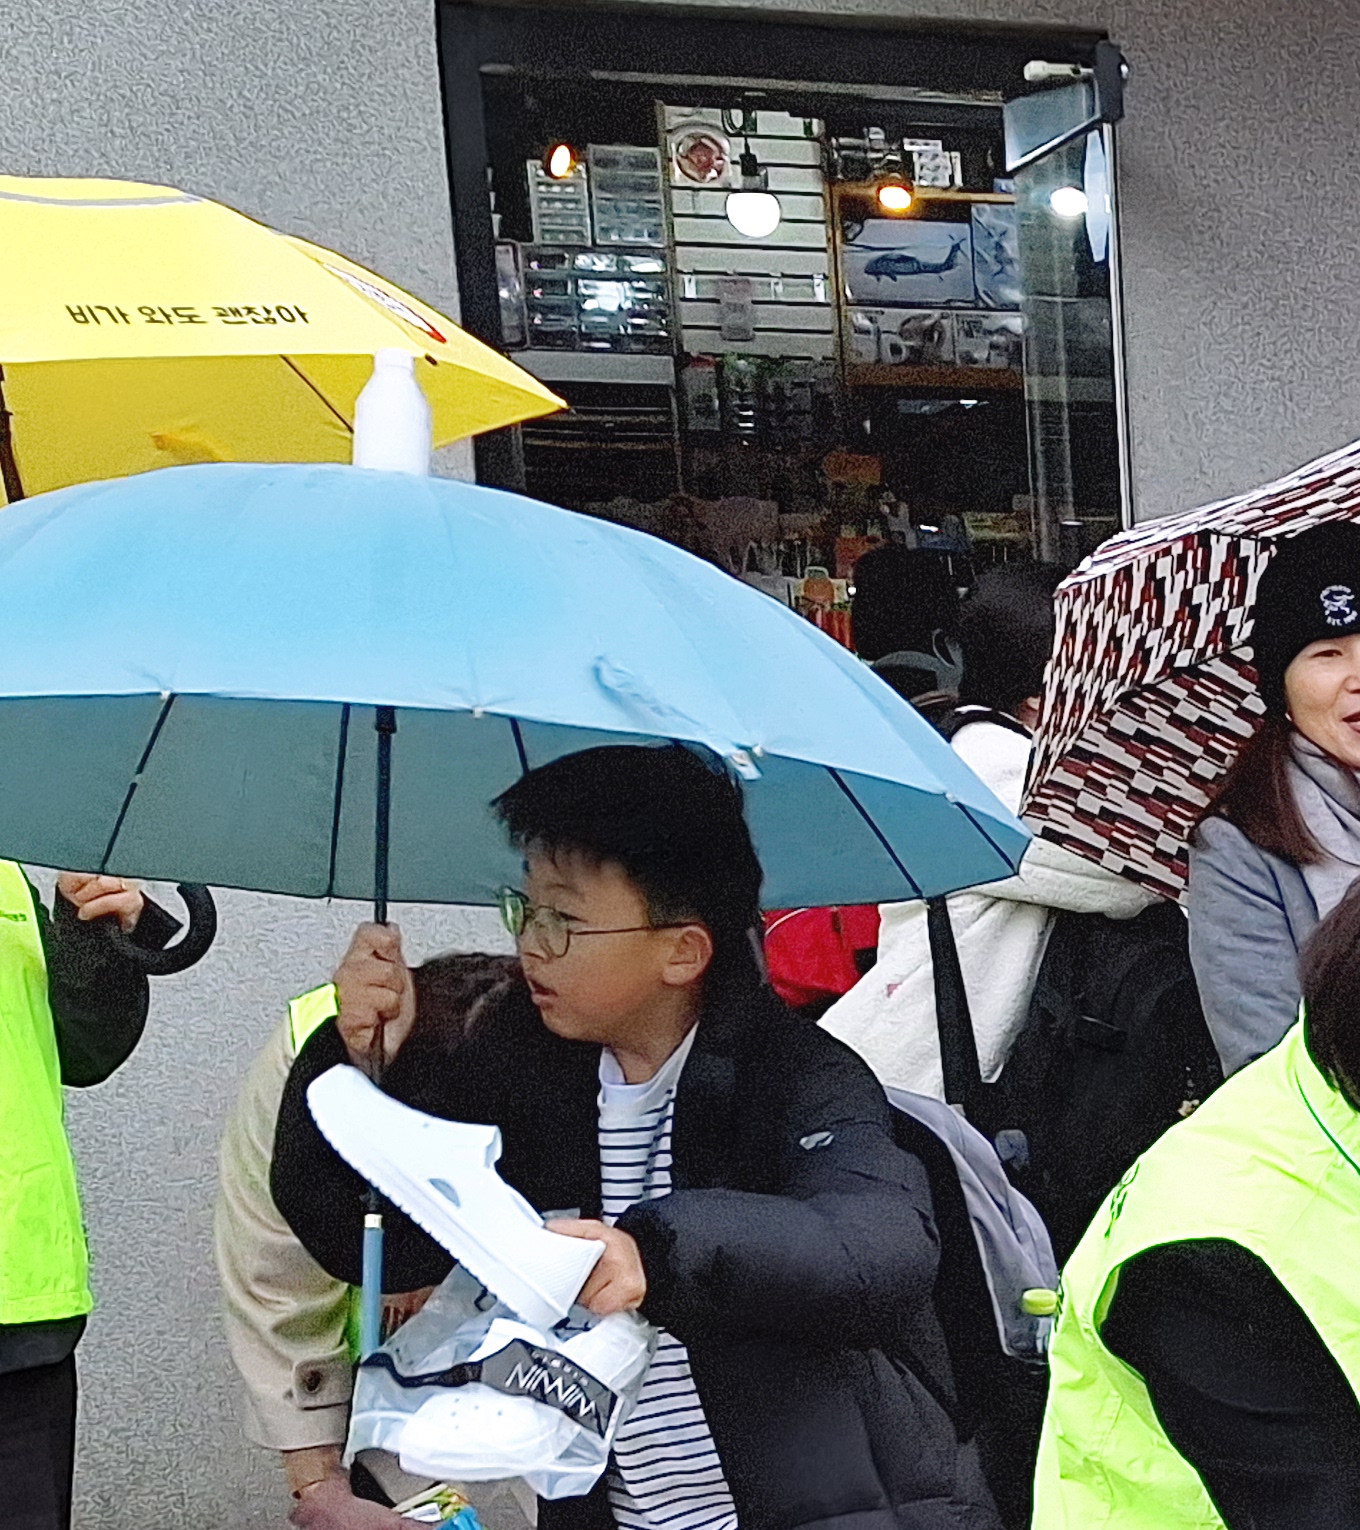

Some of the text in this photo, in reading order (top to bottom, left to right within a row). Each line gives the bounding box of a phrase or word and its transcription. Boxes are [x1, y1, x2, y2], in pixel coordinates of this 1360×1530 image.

[64, 304, 311, 326] 비가 와도 괜찮아
